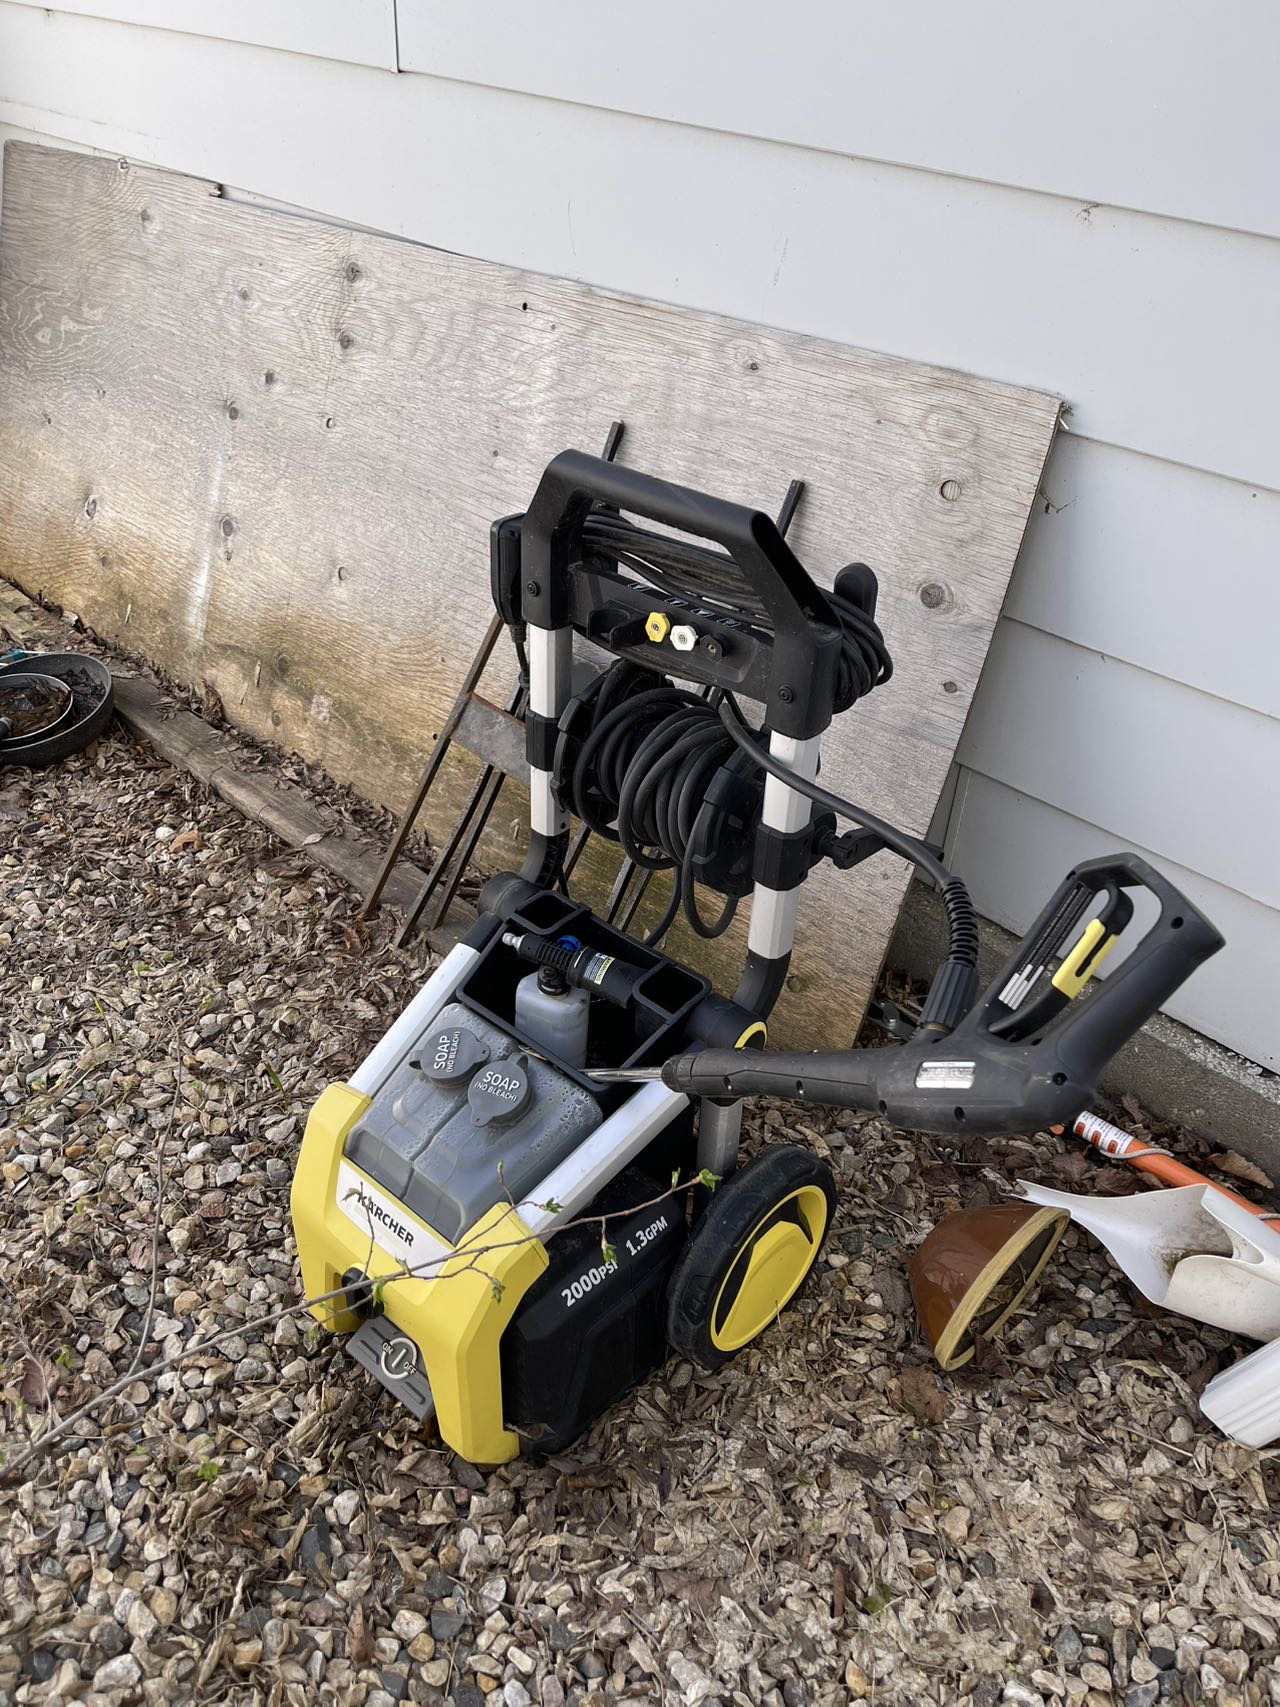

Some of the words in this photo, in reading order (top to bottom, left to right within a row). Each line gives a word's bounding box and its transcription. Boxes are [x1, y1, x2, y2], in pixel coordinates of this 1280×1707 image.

[434, 1035, 450, 1069] SOAP
[446, 1060, 454, 1073] (NO
[451, 1031, 461, 1059] BLEACH)
[474, 1081, 487, 1091] (NO
[488, 1087, 517, 1103] BLEACH)
[483, 1071, 519, 1091] SOAP
[561, 1259, 618, 1307] 2000PSI
[625, 1215, 668, 1256] 1.3GPM
[382, 1342, 394, 1355] ON
[403, 1361, 417, 1376] OFF
